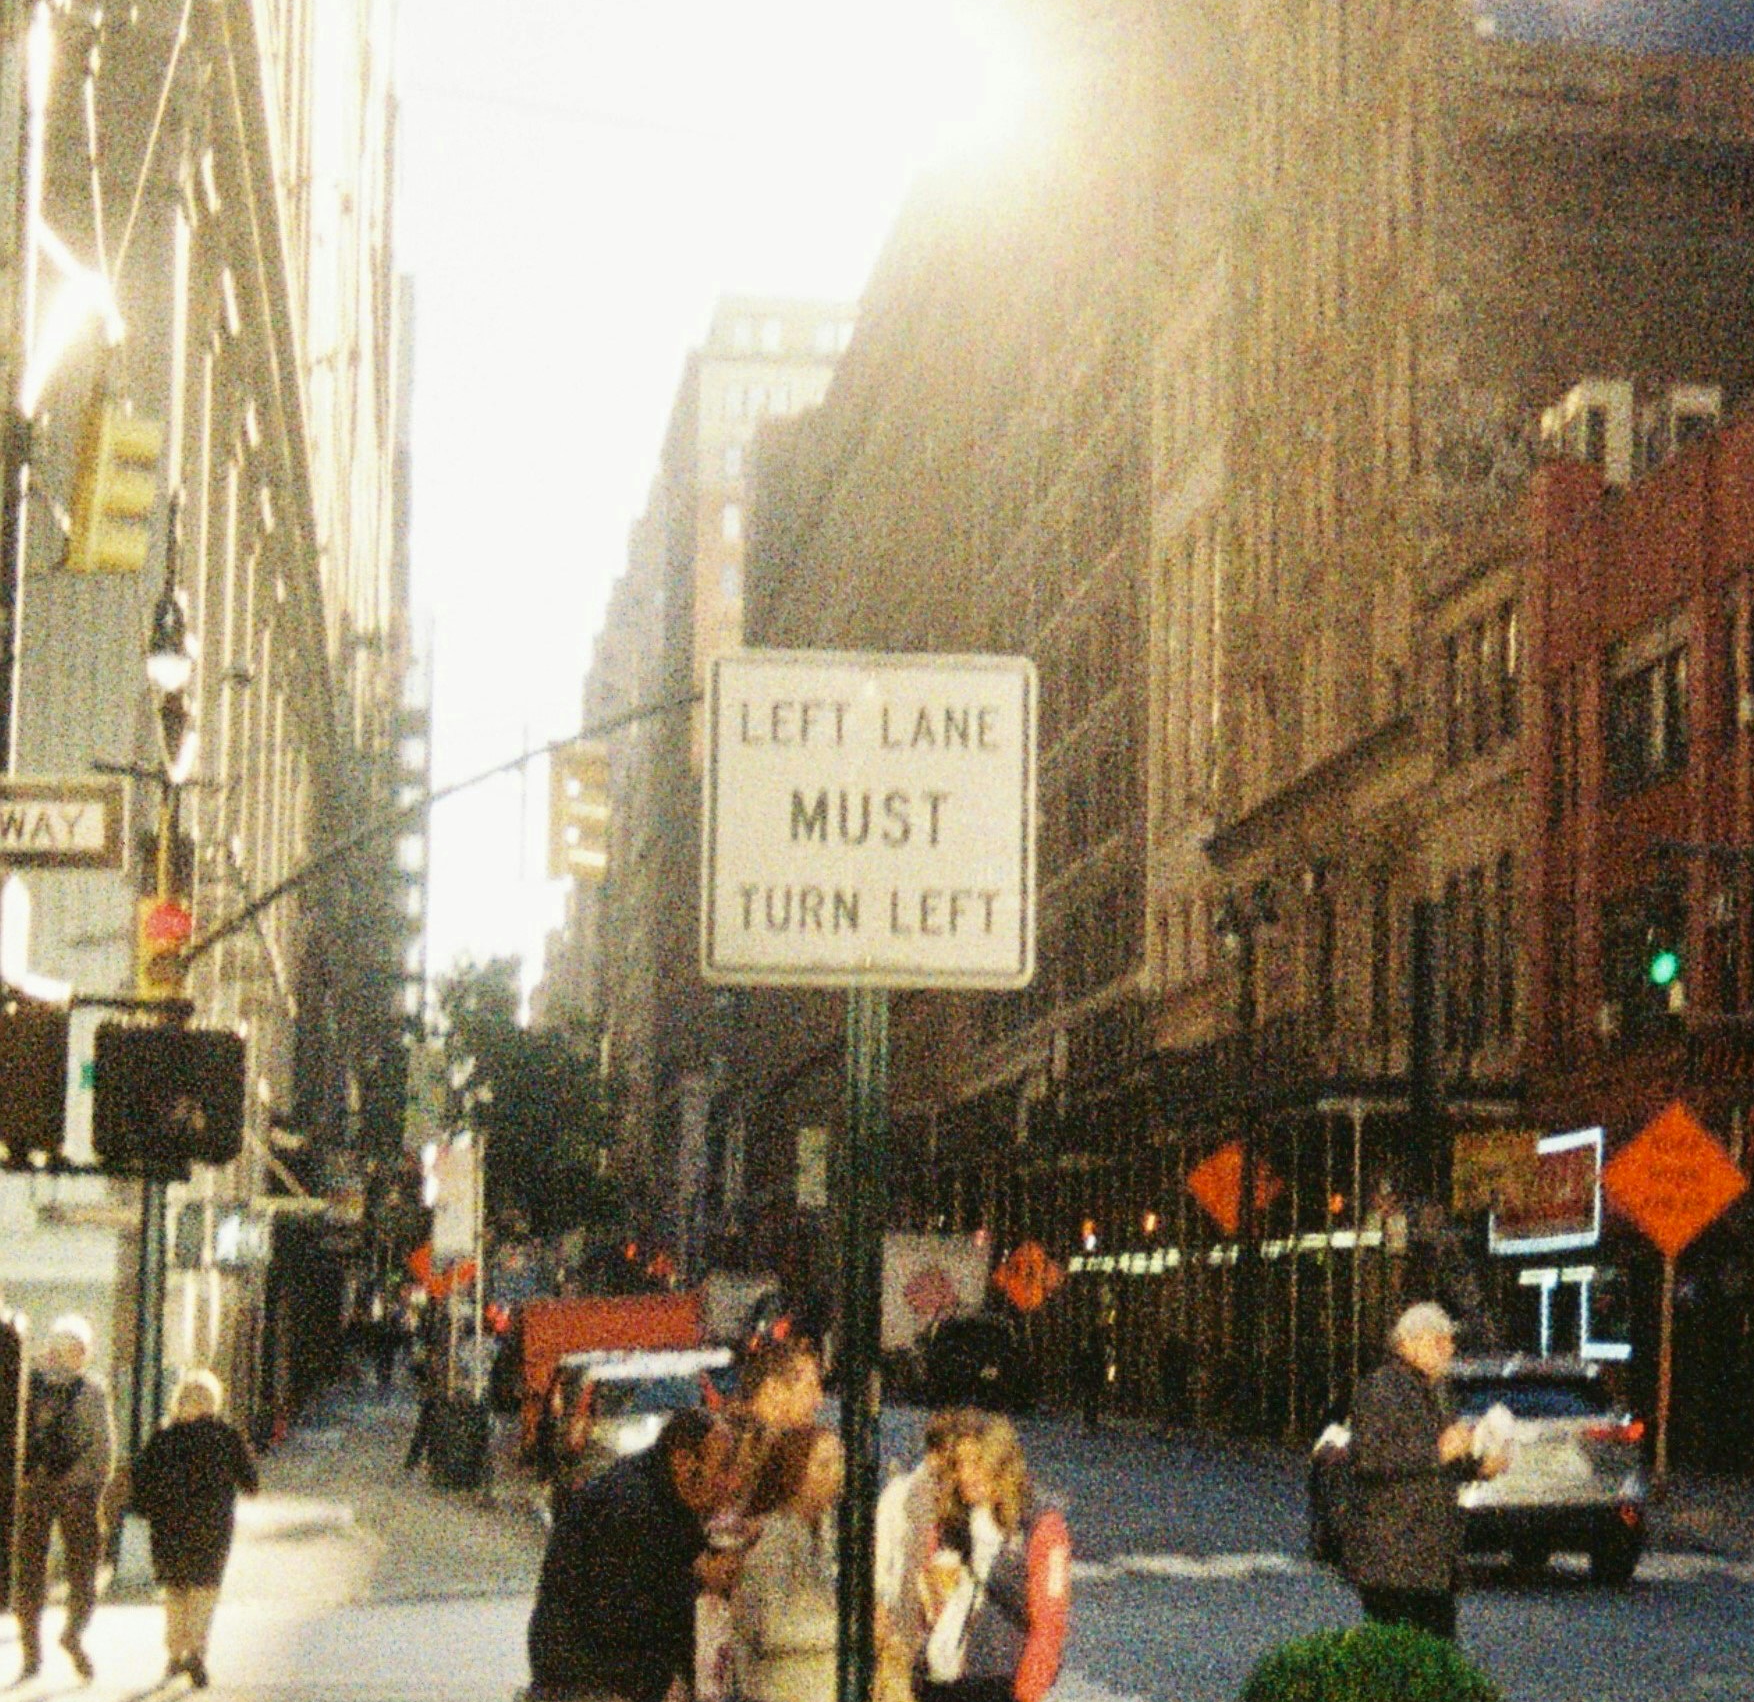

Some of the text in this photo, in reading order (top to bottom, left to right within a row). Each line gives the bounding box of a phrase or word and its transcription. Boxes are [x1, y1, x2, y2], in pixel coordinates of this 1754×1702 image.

[741, 701, 1001, 751] LEFT LANE
[0, 802, 87, 850] WAY
[789, 789, 951, 848] MUST
[737, 883, 1001, 937] TURN LEFT
